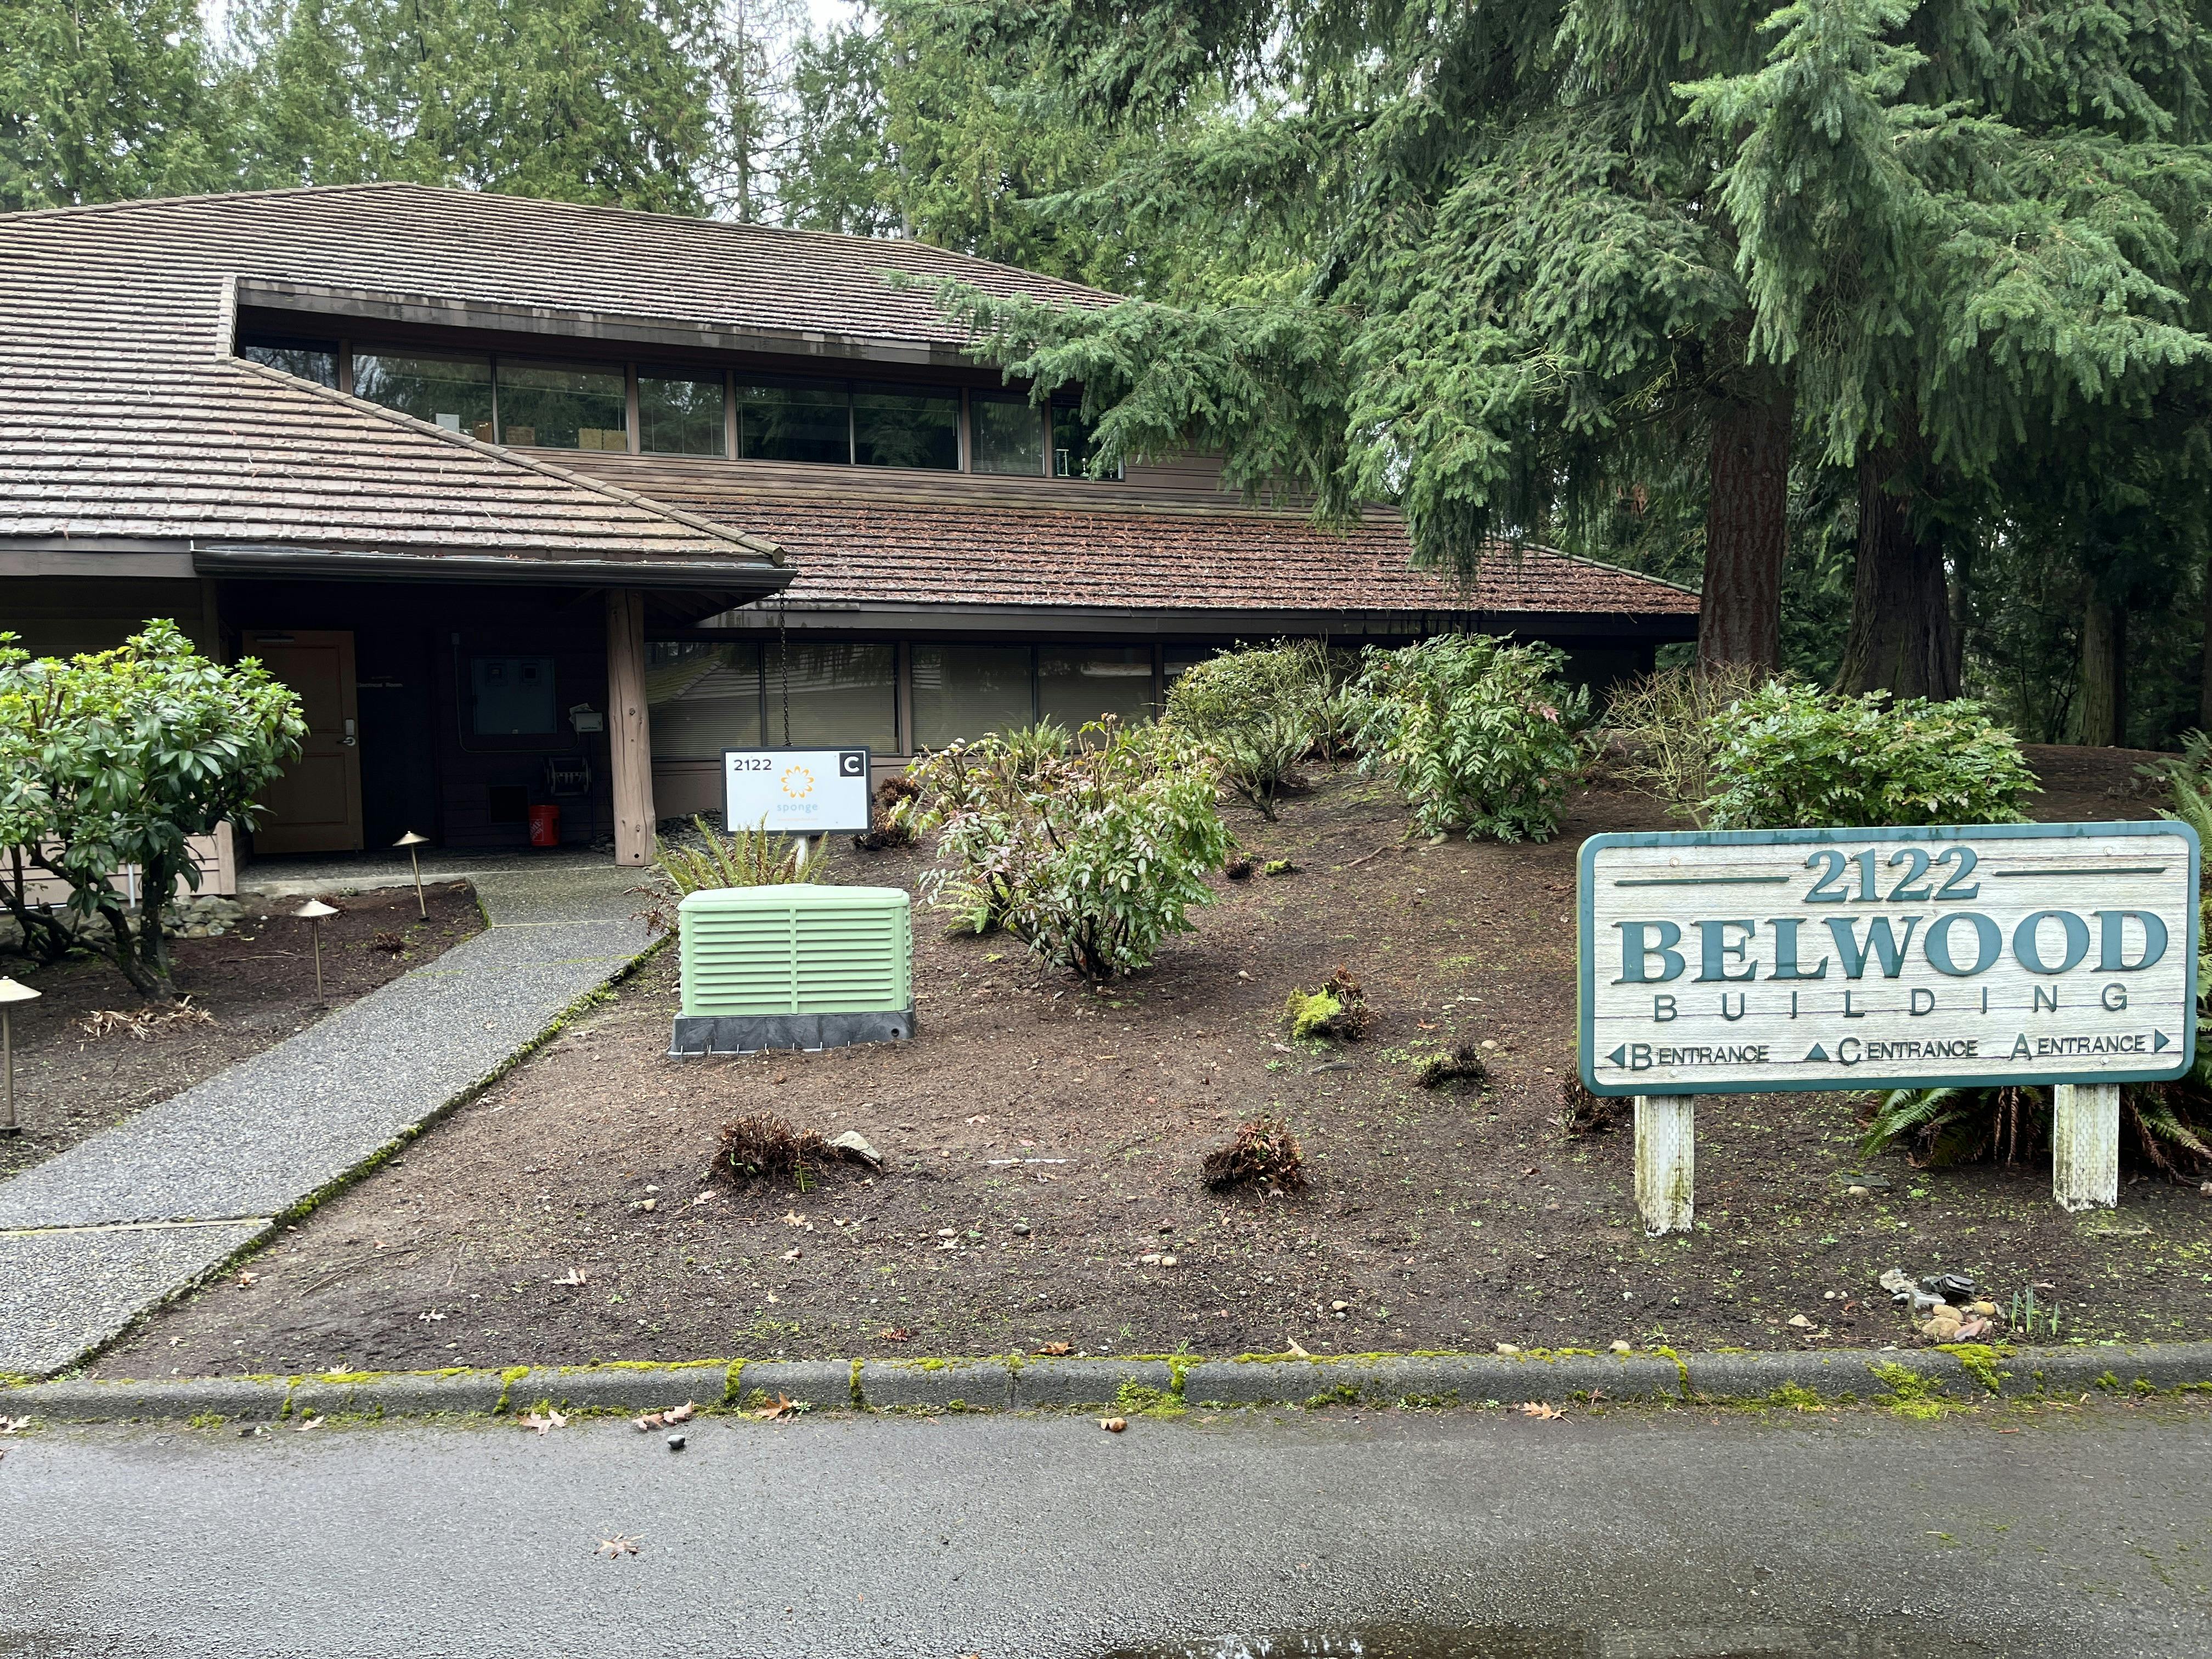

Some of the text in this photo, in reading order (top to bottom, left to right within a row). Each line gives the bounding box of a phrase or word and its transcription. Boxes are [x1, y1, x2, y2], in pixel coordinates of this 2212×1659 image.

[733, 759, 771, 770] 2122
[844, 756, 860, 772] C
[777, 803, 818, 813] sponge
[1804, 845, 1980, 903] 2122
[1611, 910, 2168, 984] BELWOOD
[1654, 983, 2128, 1022] BUILDING
[1658, 1045, 1770, 1064] ENTRANCE
[1867, 1040, 1979, 1060] ENTRANCE
[2038, 1035, 2146, 1055] ENTRANCE
